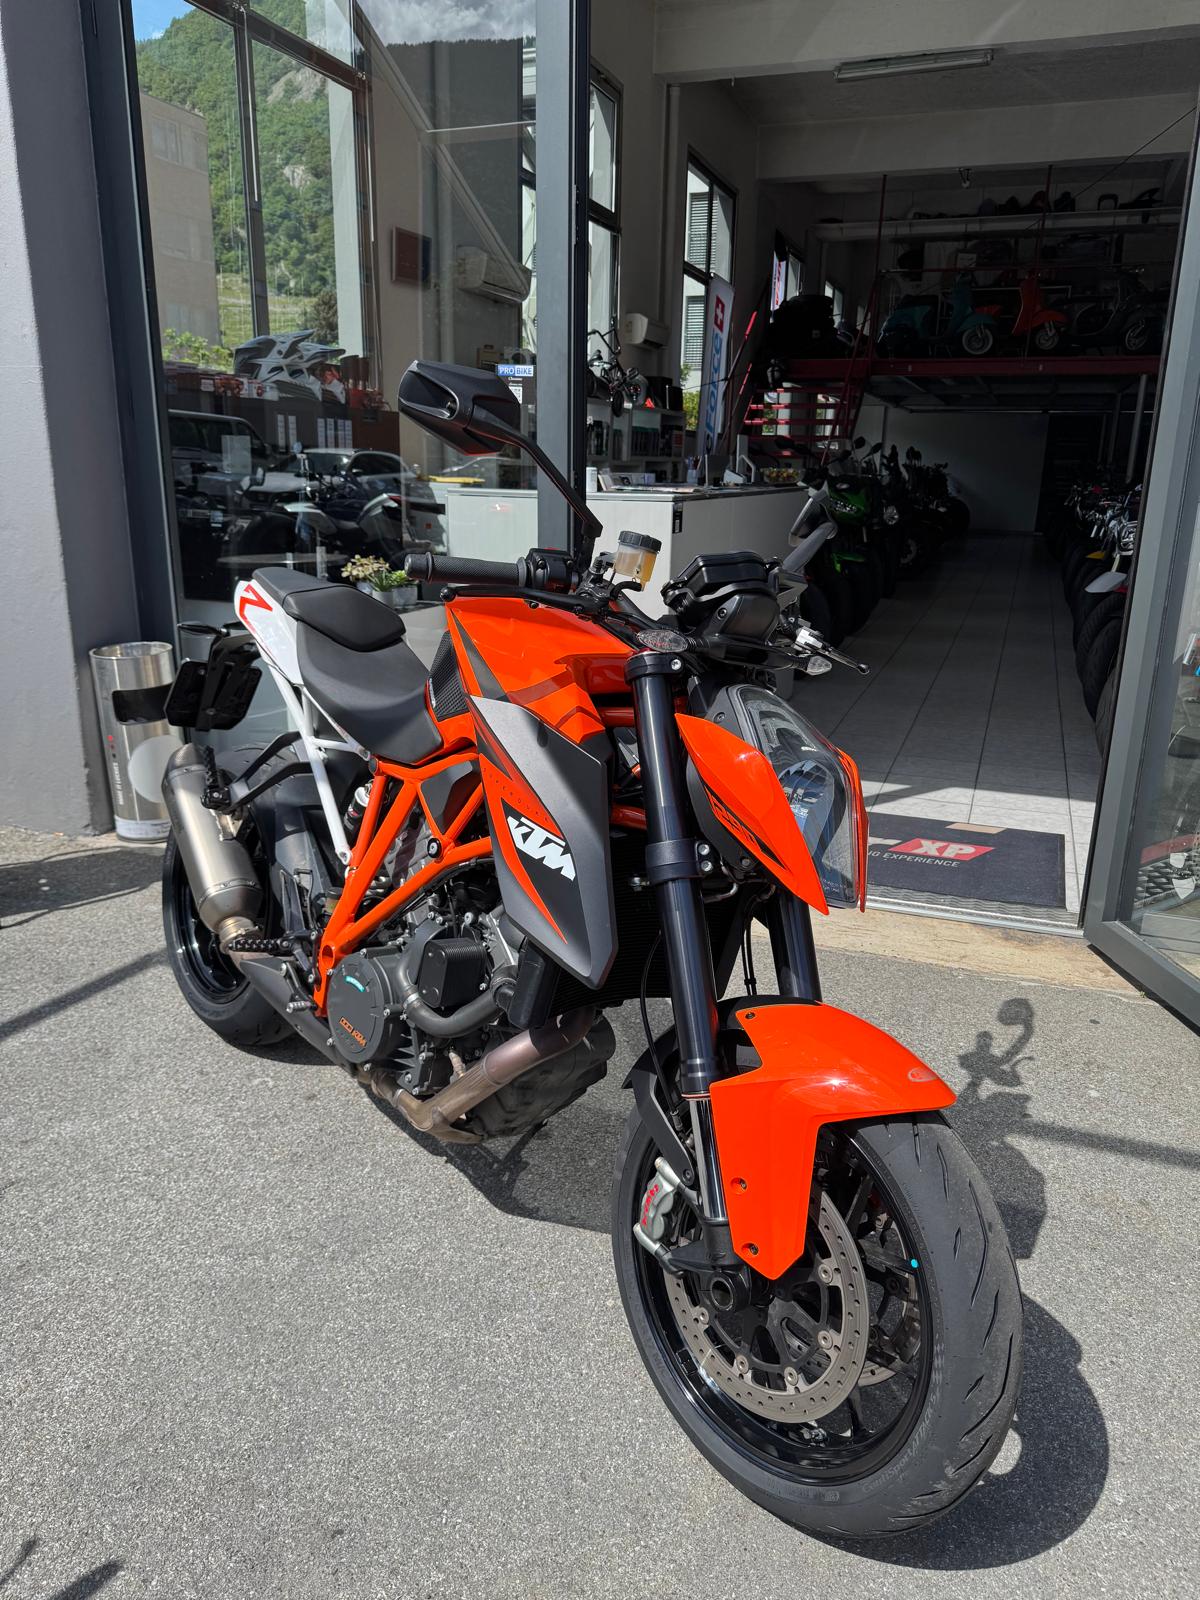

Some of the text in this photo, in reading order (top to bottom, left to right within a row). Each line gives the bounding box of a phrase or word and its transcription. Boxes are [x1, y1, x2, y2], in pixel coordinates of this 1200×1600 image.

[499, 366, 533, 376] PRO BIKE
[507, 816, 576, 881] KTM
[911, 840, 976, 858] XP
[882, 851, 961, 868] EXPERIENCE
